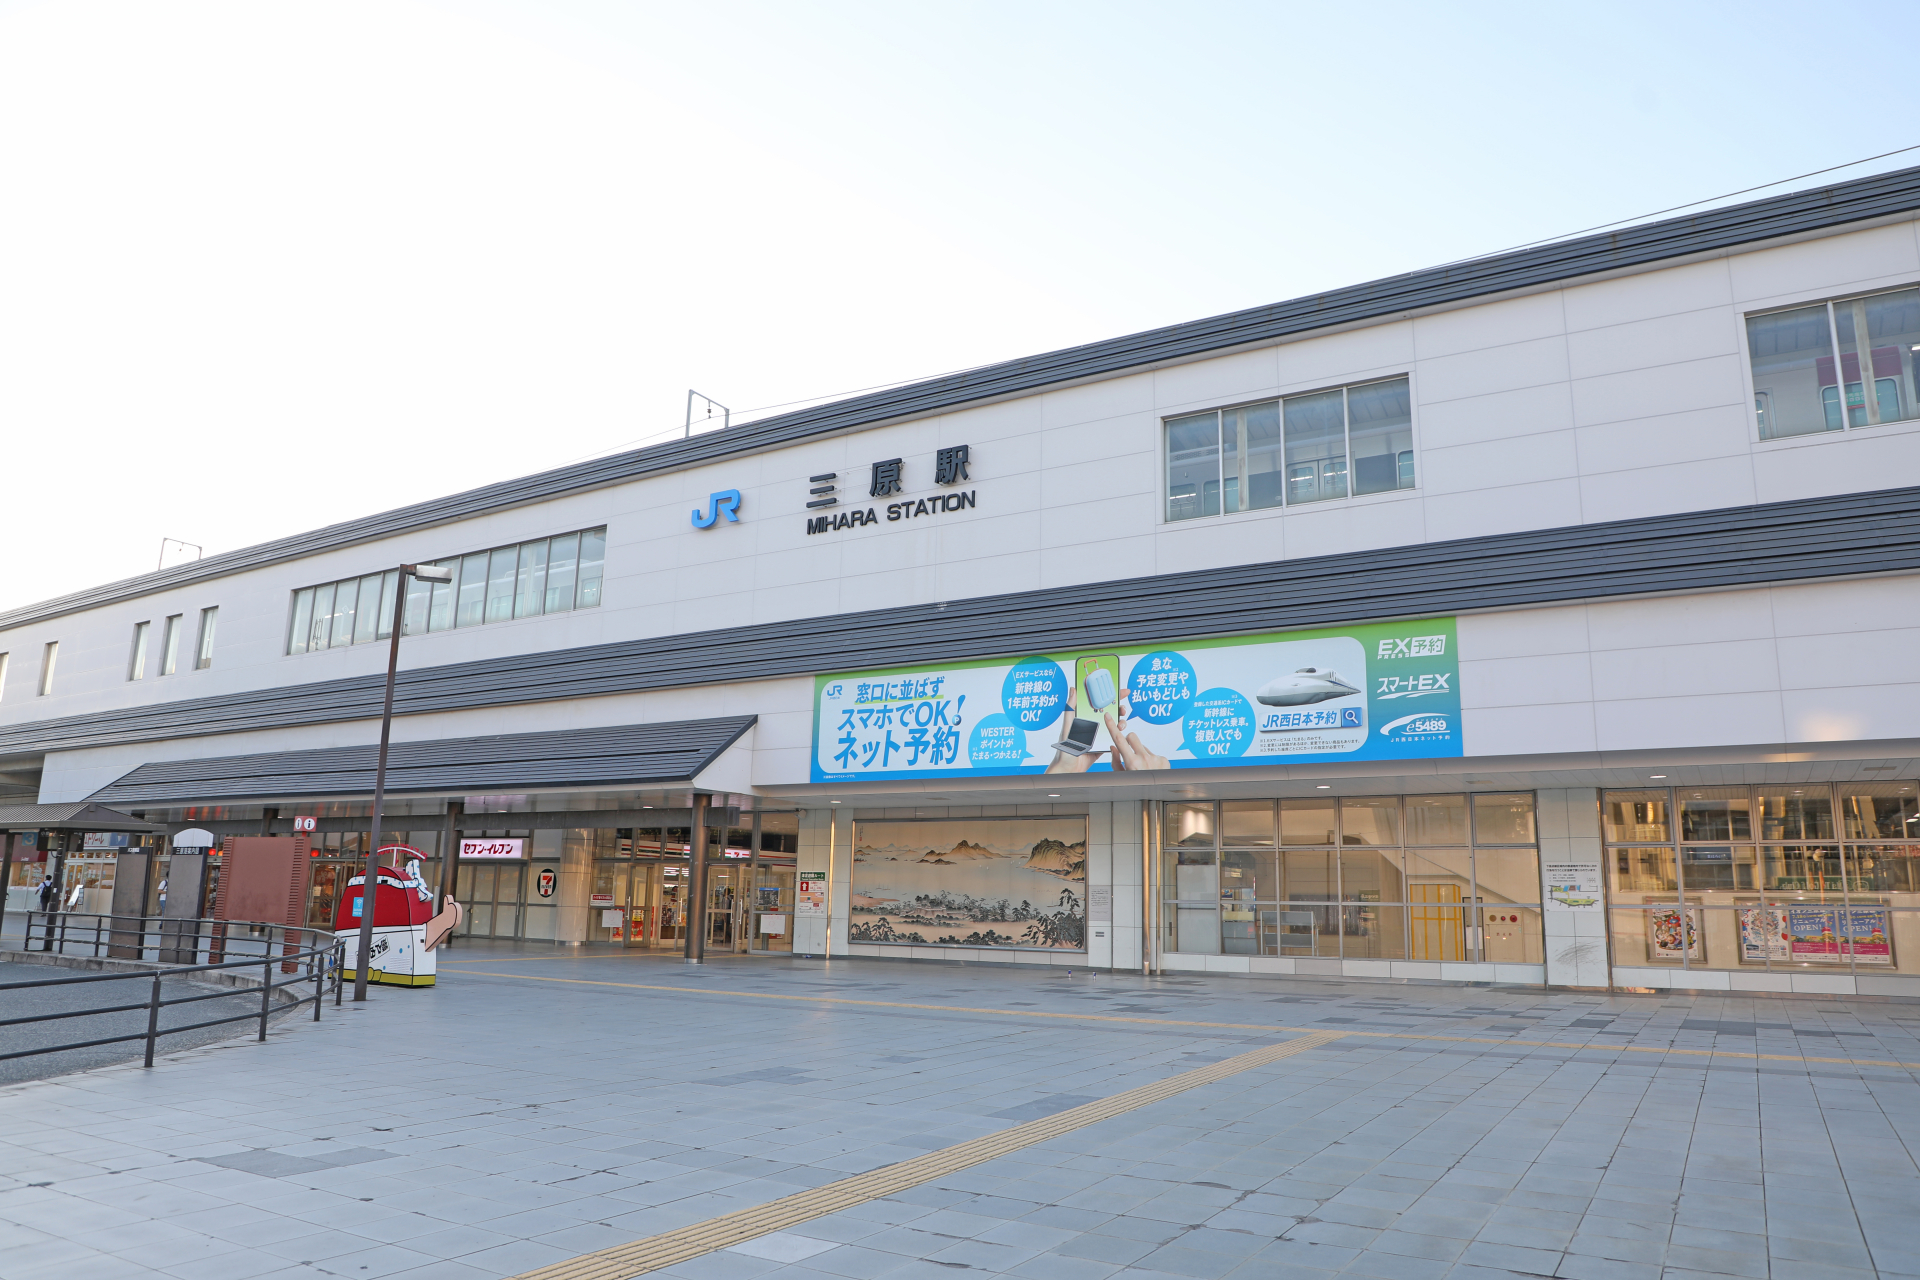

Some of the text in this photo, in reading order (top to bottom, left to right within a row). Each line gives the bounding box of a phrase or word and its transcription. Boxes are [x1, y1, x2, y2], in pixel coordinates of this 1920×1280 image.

[806, 444, 970, 508] 三原駅
[691, 488, 741, 528] JR
[806, 490, 976, 535] MIHARA STATION
[1151, 657, 1172, 671] 急な
[1137, 671, 1189, 688] 予定変更や
[1377, 673, 1451, 693] スマートEX
[827, 685, 842, 696] JR
[855, 676, 945, 703] 窓口に並ばず
[1015, 681, 1052, 694] 新幹線の
[1132, 686, 1190, 703] 払いもどしも
[1008, 694, 1058, 709] 1年前予約が
[1020, 709, 1042, 722] OK!
[1149, 703, 1173, 717] OK!
[1204, 707, 1234, 718] 新幹線に
[1262, 711, 1337, 729] JR西日本予約
[1406, 720, 1447, 732] e5489
[981, 727, 1015, 737] WESTER
[1195, 728, 1242, 742] 複数人でも
[833, 726, 961, 769] ネット予約
[980, 738, 1014, 749] ポイントが
[1208, 742, 1231, 755] OK!
[25, 833, 34, 845] 3
[542, 875, 552, 895] 7
